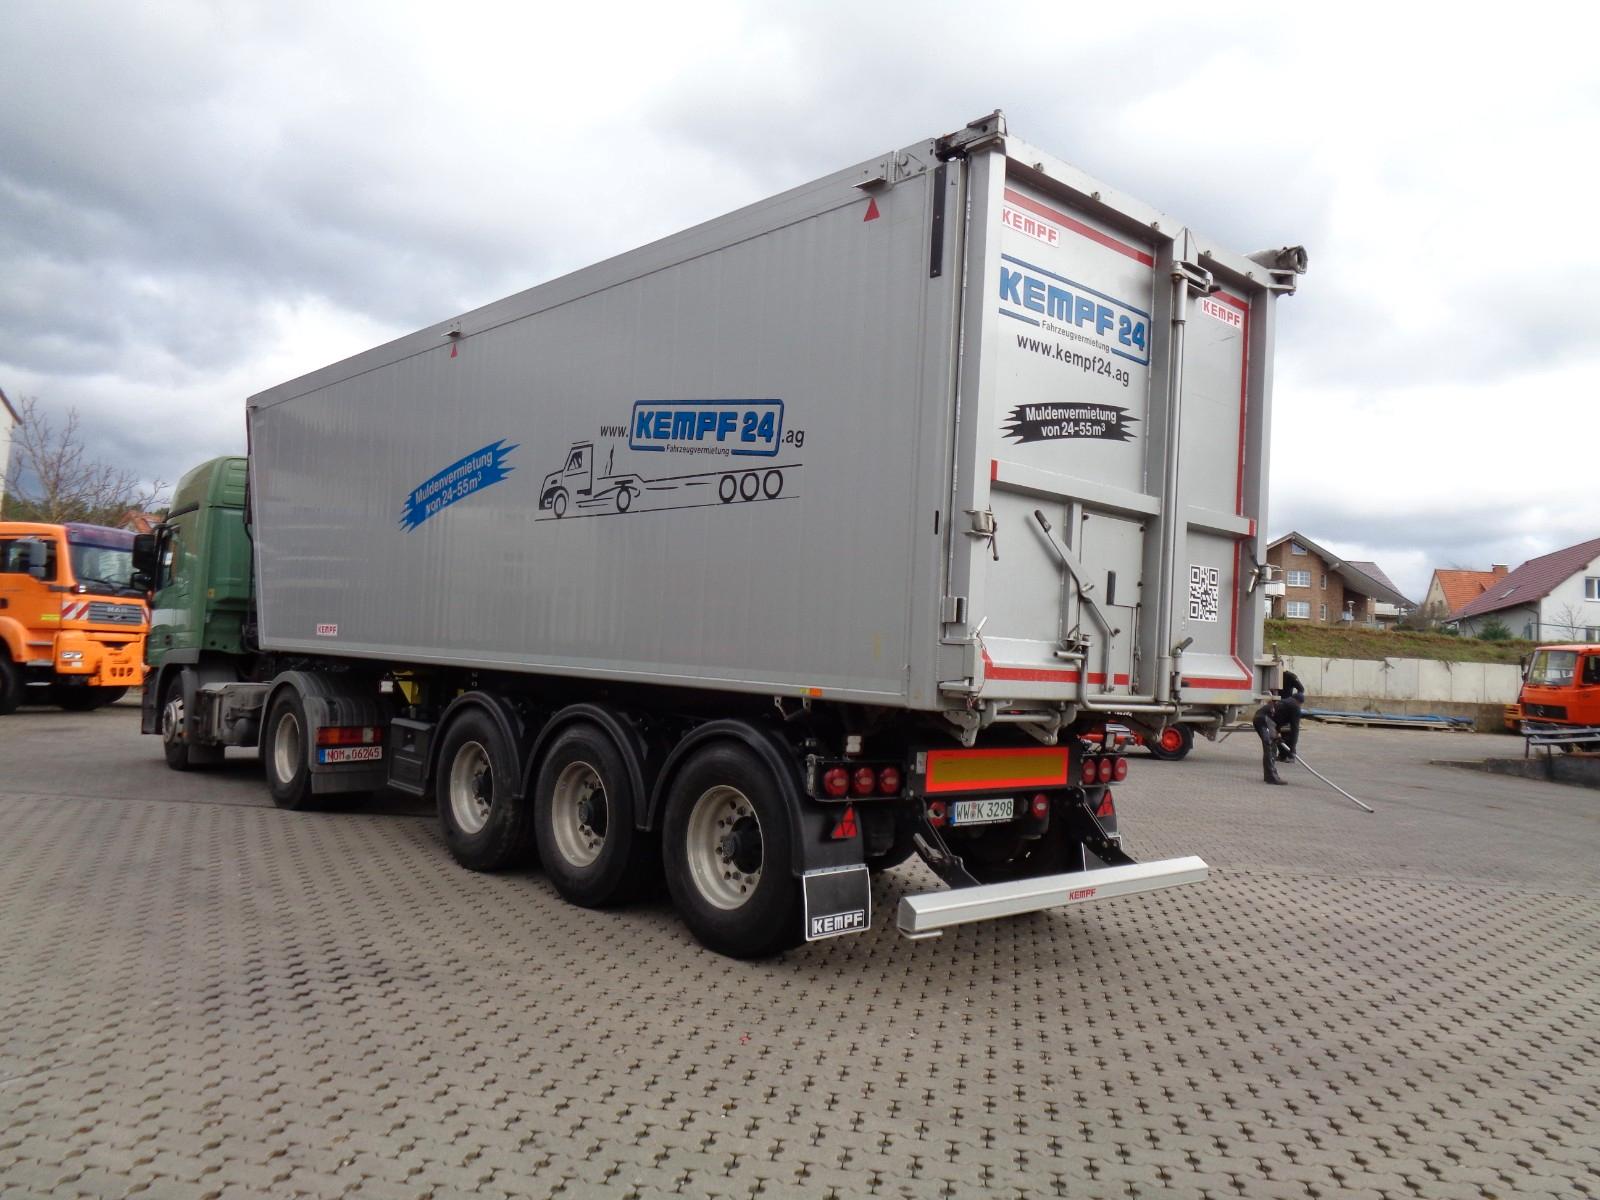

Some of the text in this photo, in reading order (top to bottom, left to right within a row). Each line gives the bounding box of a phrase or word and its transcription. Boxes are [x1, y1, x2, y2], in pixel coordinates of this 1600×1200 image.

[1002, 208, 1057, 243] KEMPF
[1000, 266, 1145, 351] KEMPF 24
[1203, 300, 1240, 326] KEMPF
[1042, 320, 1110, 353] Fahrzeugvermietung
[1017, 334, 1130, 387] www.kempf24.ag
[1025, 406, 1117, 424] Muldenvermietung
[635, 411, 738, 442] KEMPF
[740, 411, 775, 443] 24
[1041, 425, 1060, 437] von
[666, 443, 730, 457] Fahrzeugvermietung
[415, 451, 493, 505] Muldenvermietung
[425, 498, 441, 514] von
[319, 625, 337, 634] KEMPF
[987, 801, 1013, 818] 3298
[1069, 888, 1096, 900] KEMPF
[814, 912, 863, 934] KEMPF
